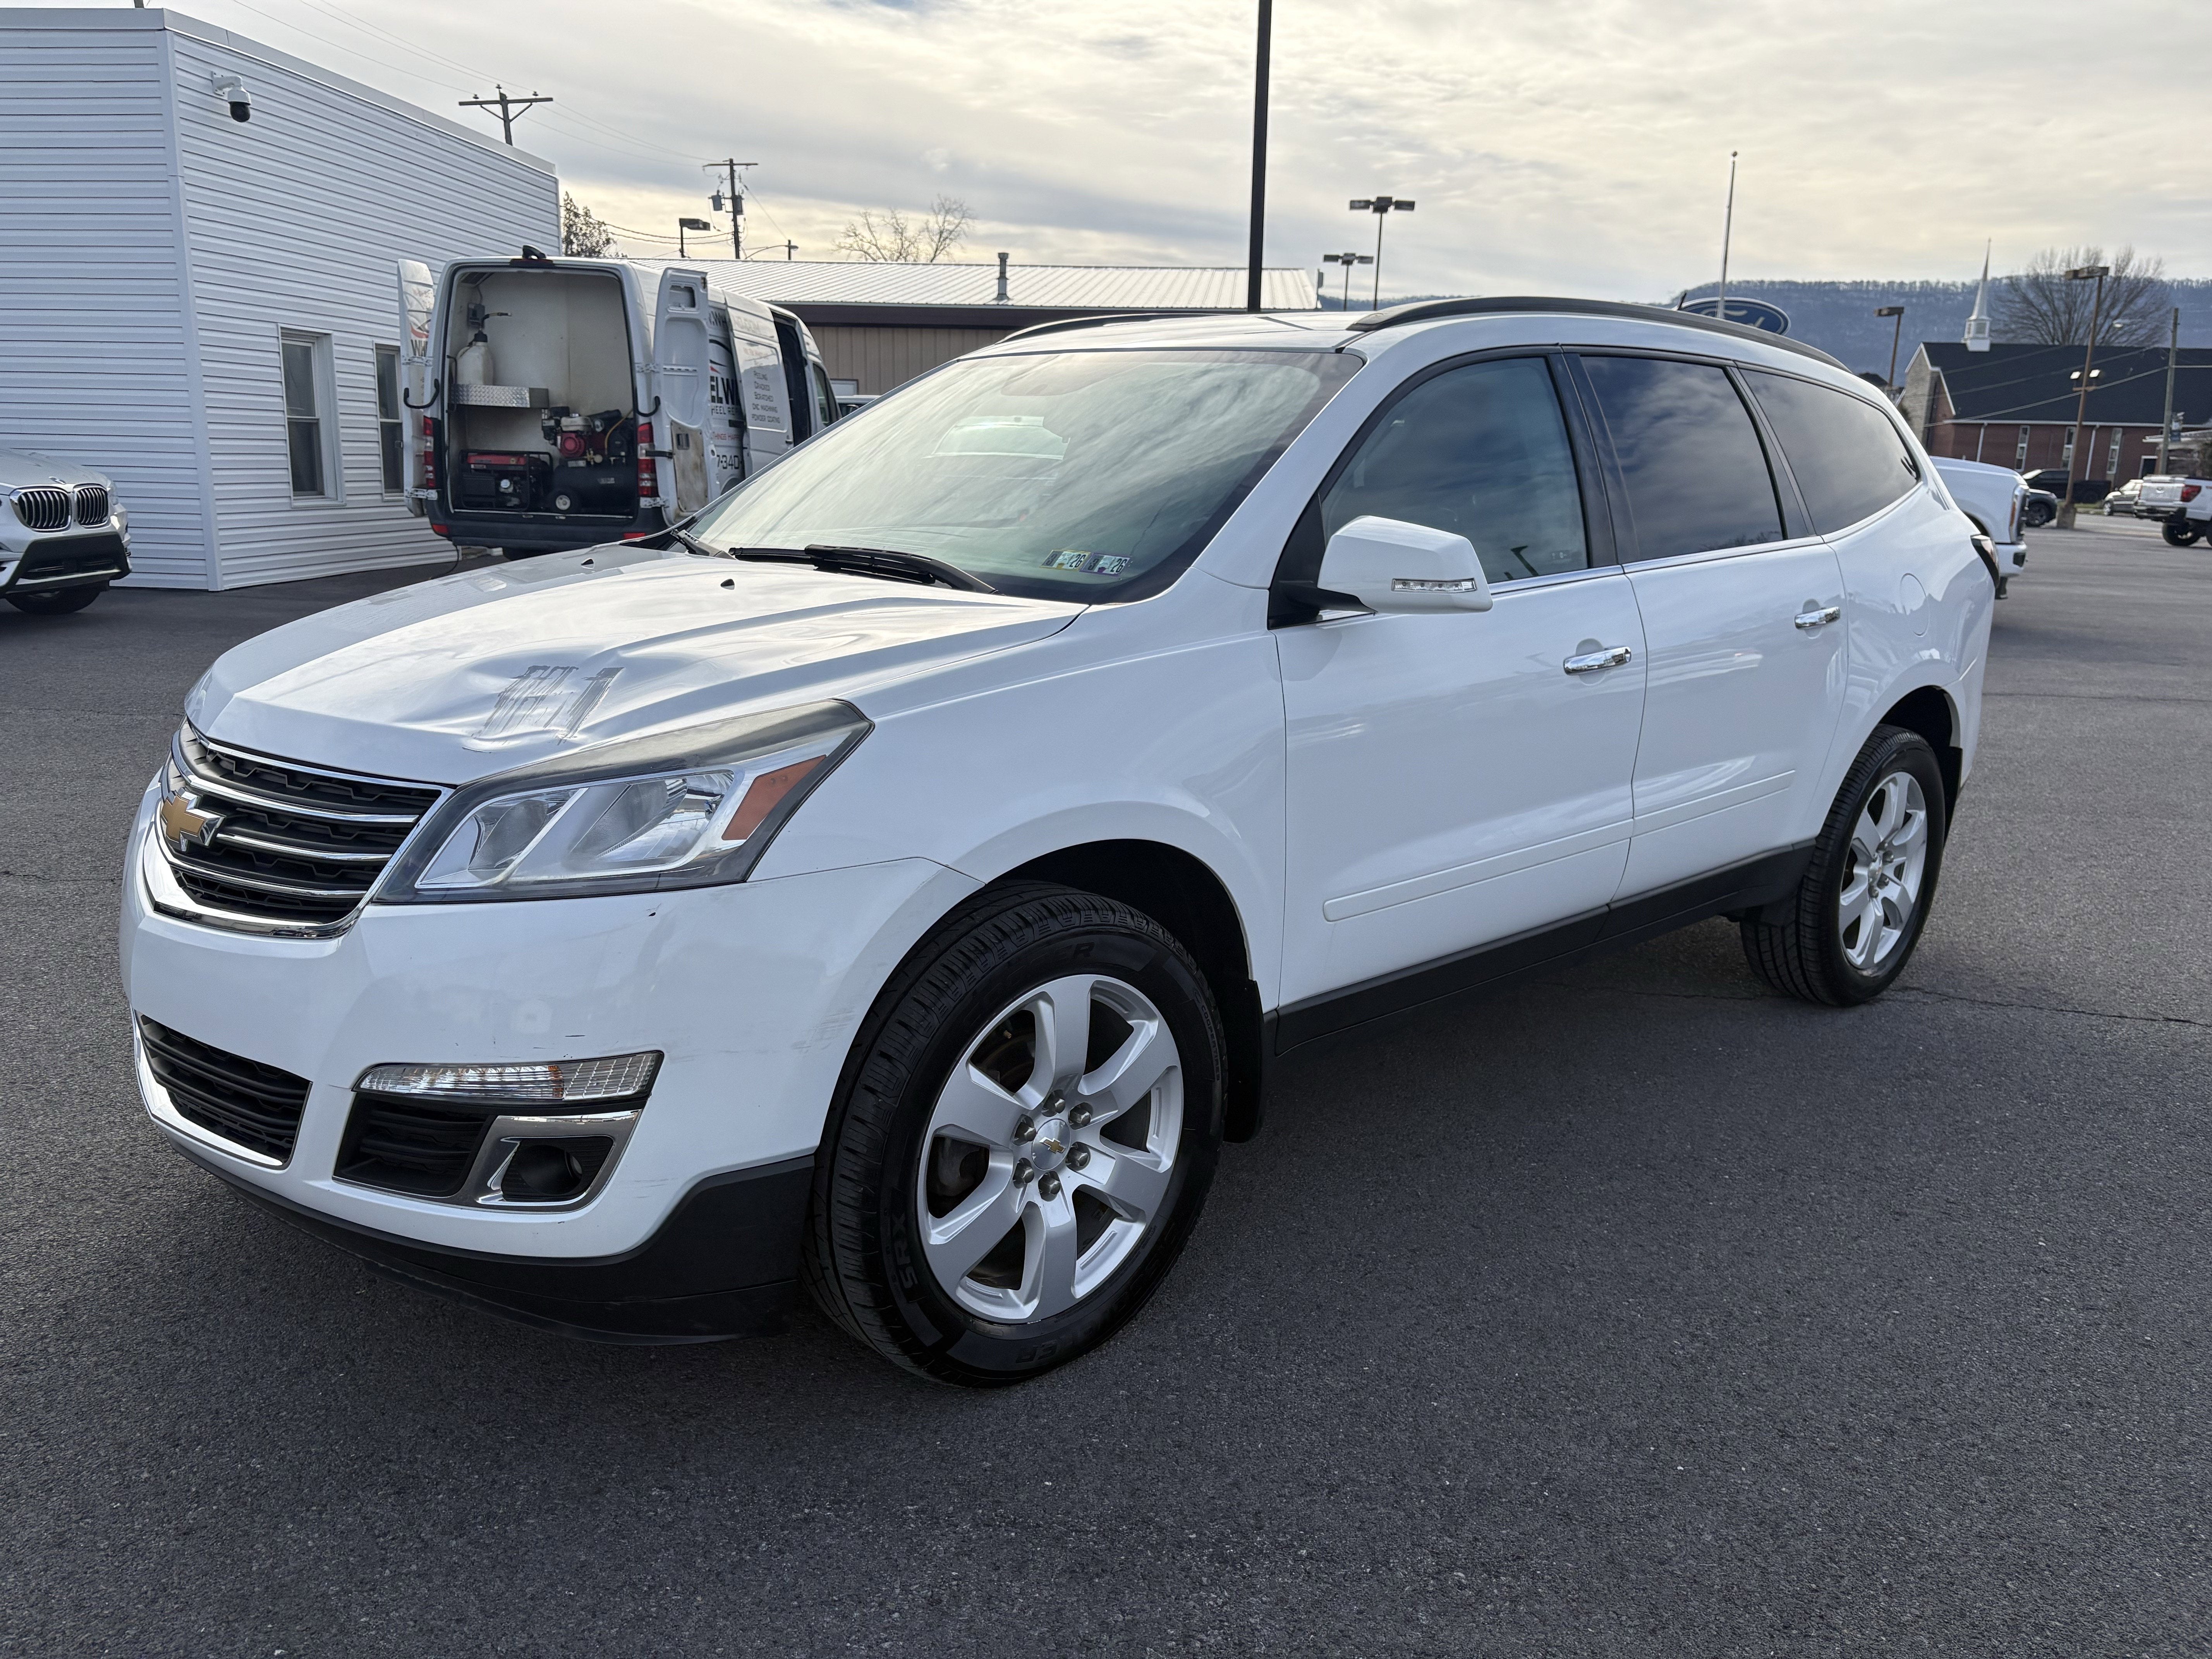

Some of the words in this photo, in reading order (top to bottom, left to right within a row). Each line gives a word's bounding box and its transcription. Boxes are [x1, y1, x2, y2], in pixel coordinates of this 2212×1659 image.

[1046, 553, 1058, 565] 3
[1069, 554, 1086, 569] 26
[1087, 558, 1098, 571] 3
[1110, 558, 1127, 574] 26
[891, 1212, 918, 1289] SRX
